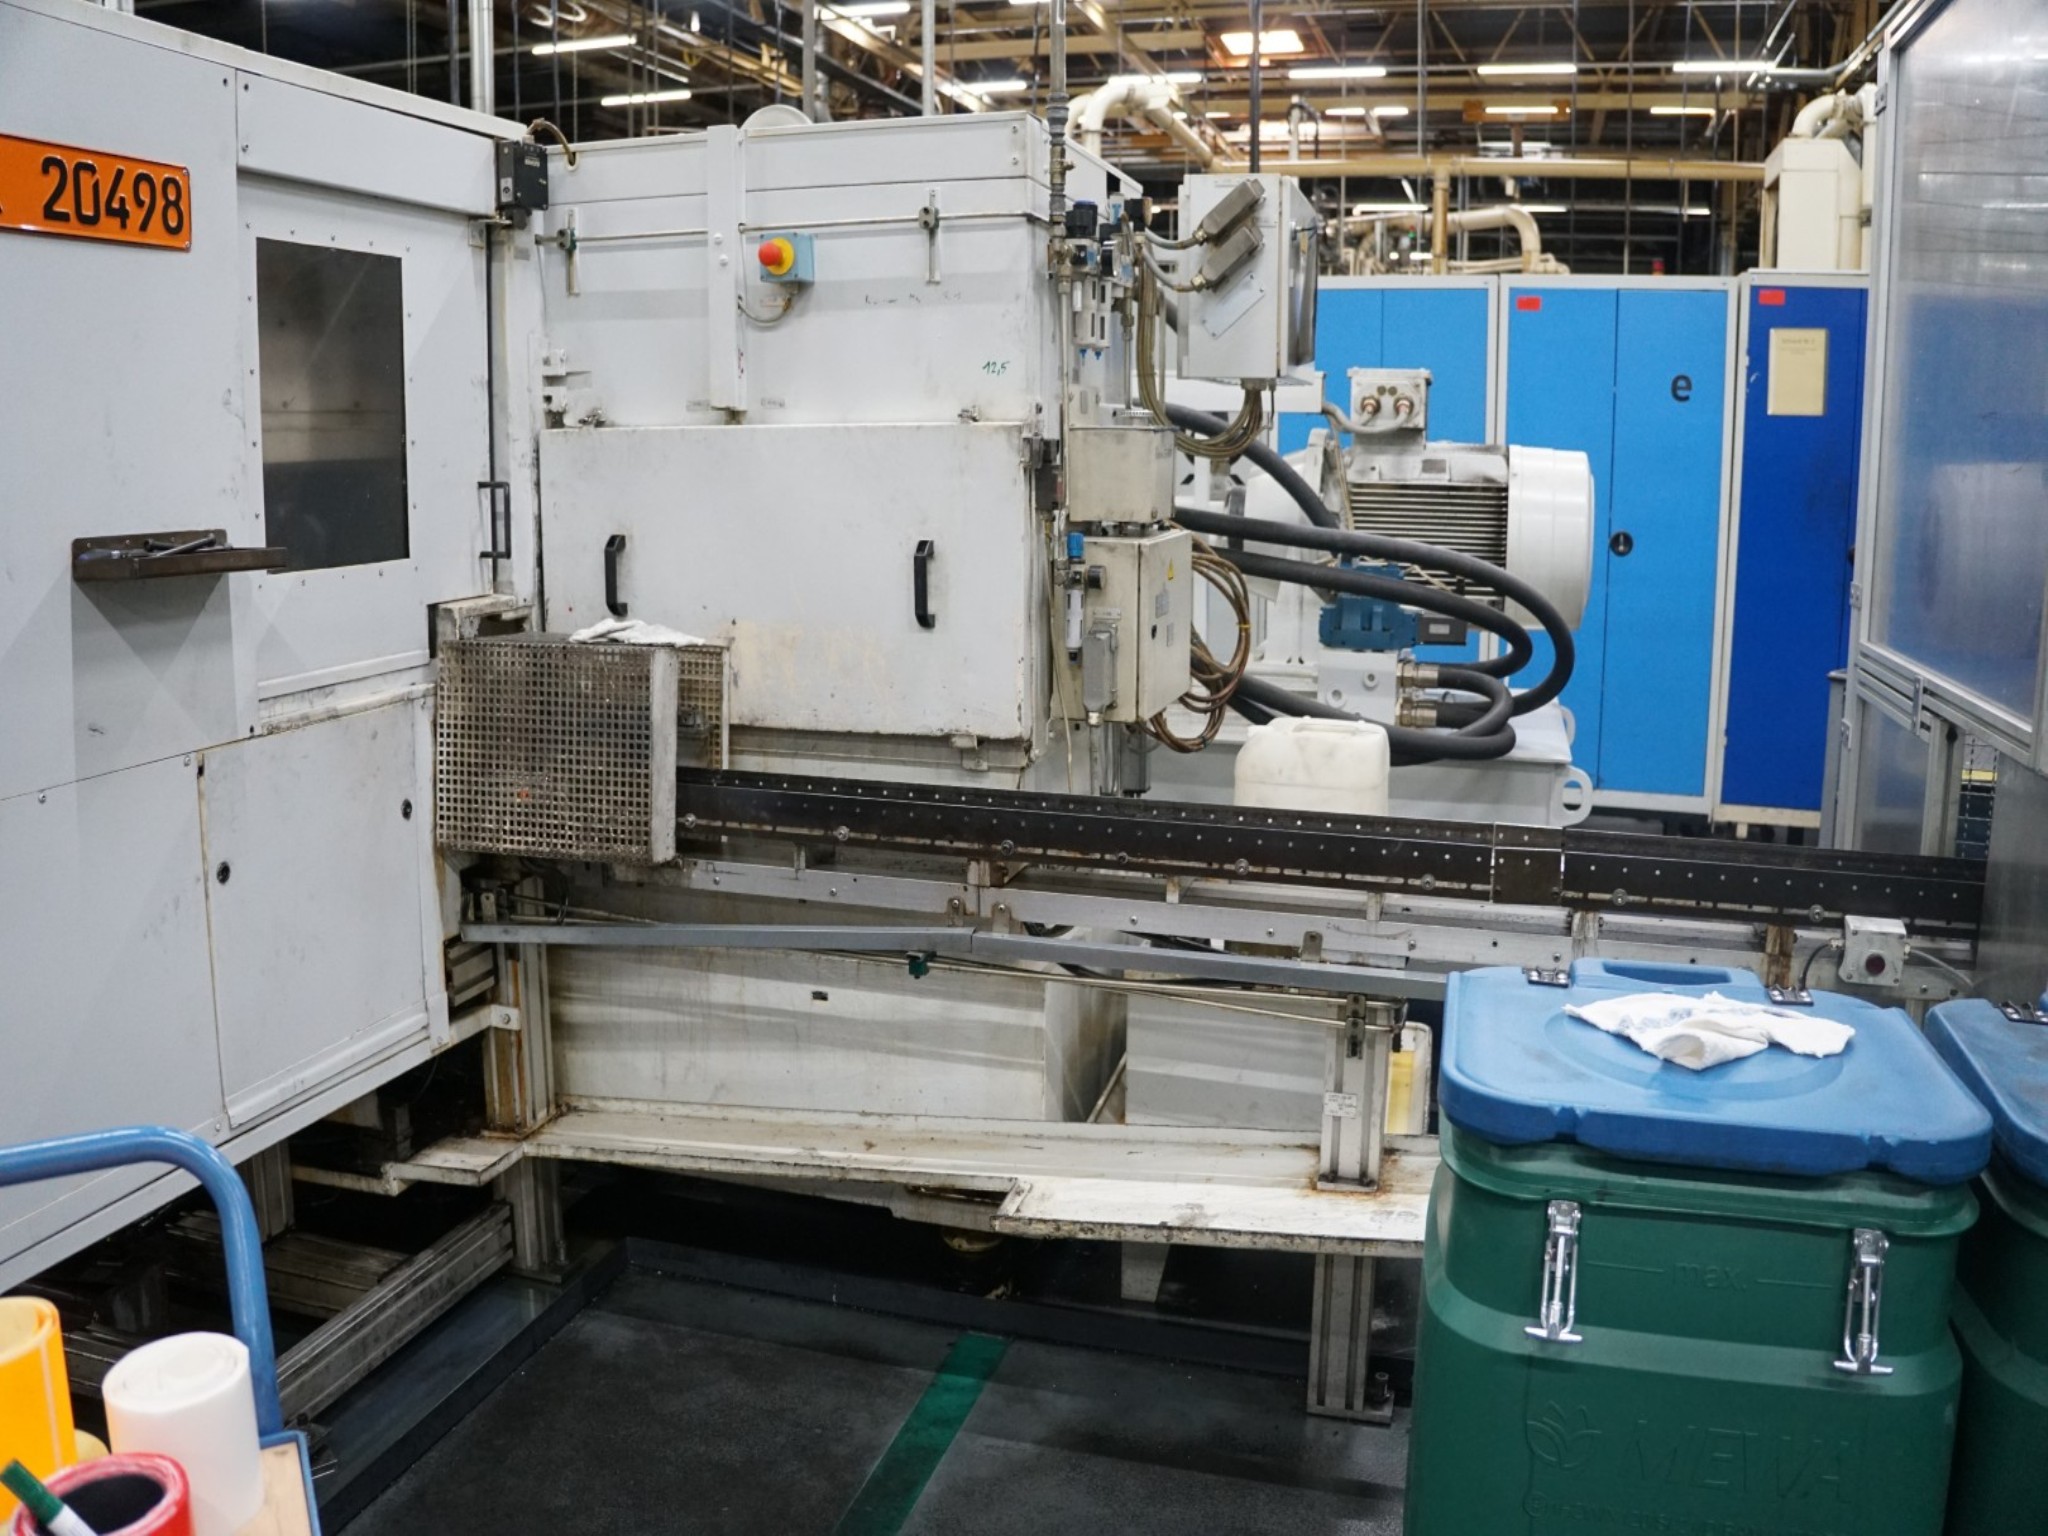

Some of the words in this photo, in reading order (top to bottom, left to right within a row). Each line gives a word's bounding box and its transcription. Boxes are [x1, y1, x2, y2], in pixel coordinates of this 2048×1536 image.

[41, 155, 184, 235] 20498
[982, 360, 1010, 376] 12,5
[1671, 374, 1692, 402] e
